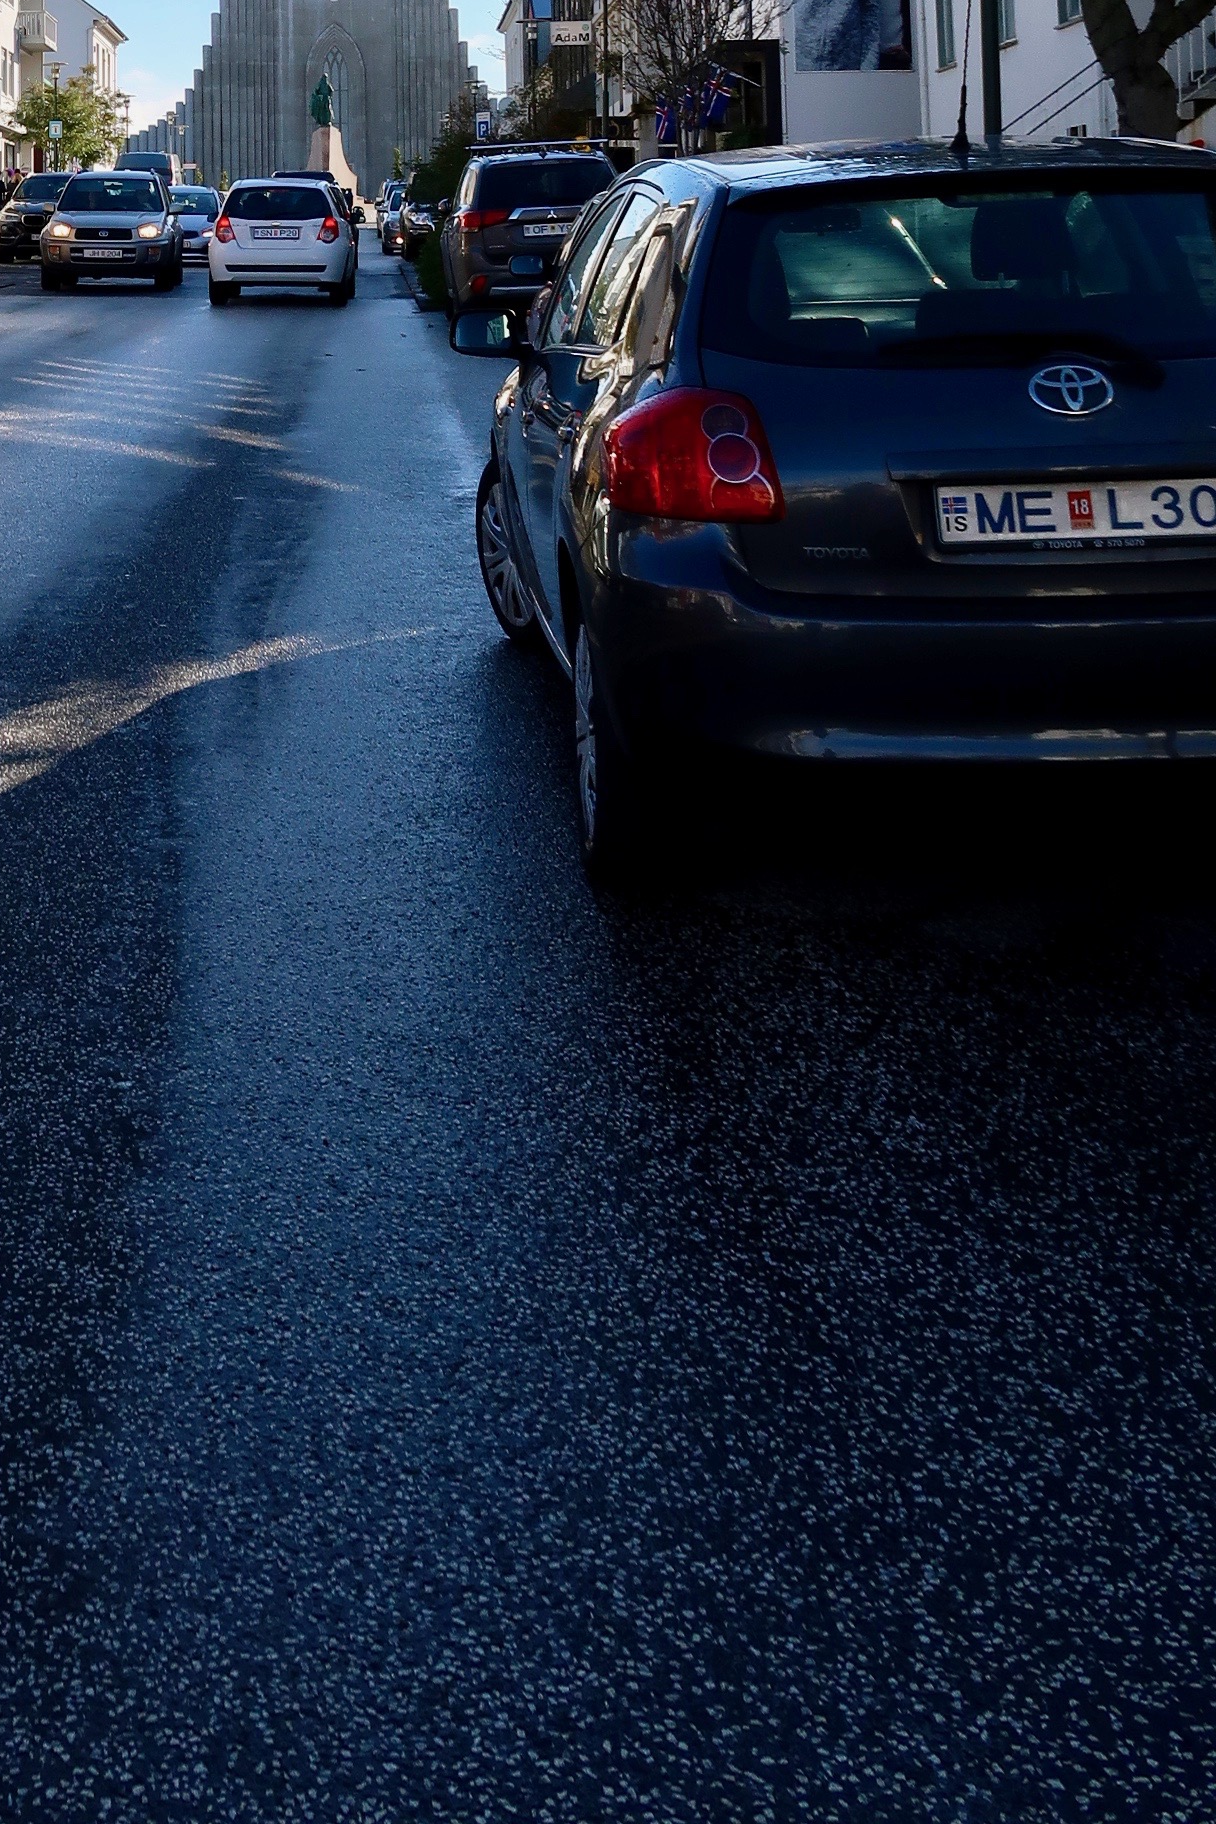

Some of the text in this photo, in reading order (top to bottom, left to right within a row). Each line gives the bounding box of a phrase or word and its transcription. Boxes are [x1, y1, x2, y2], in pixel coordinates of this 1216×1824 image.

[480, 123, 487, 136] P
[532, 226, 548, 234] OF
[974, 491, 1056, 533] ME
[1071, 498, 1090, 515] 18
[945, 516, 968, 532] IS
[1049, 540, 1083, 549] TOYOTA
[1124, 538, 1145, 547] 5070
[803, 546, 870, 559] TOYOTA
